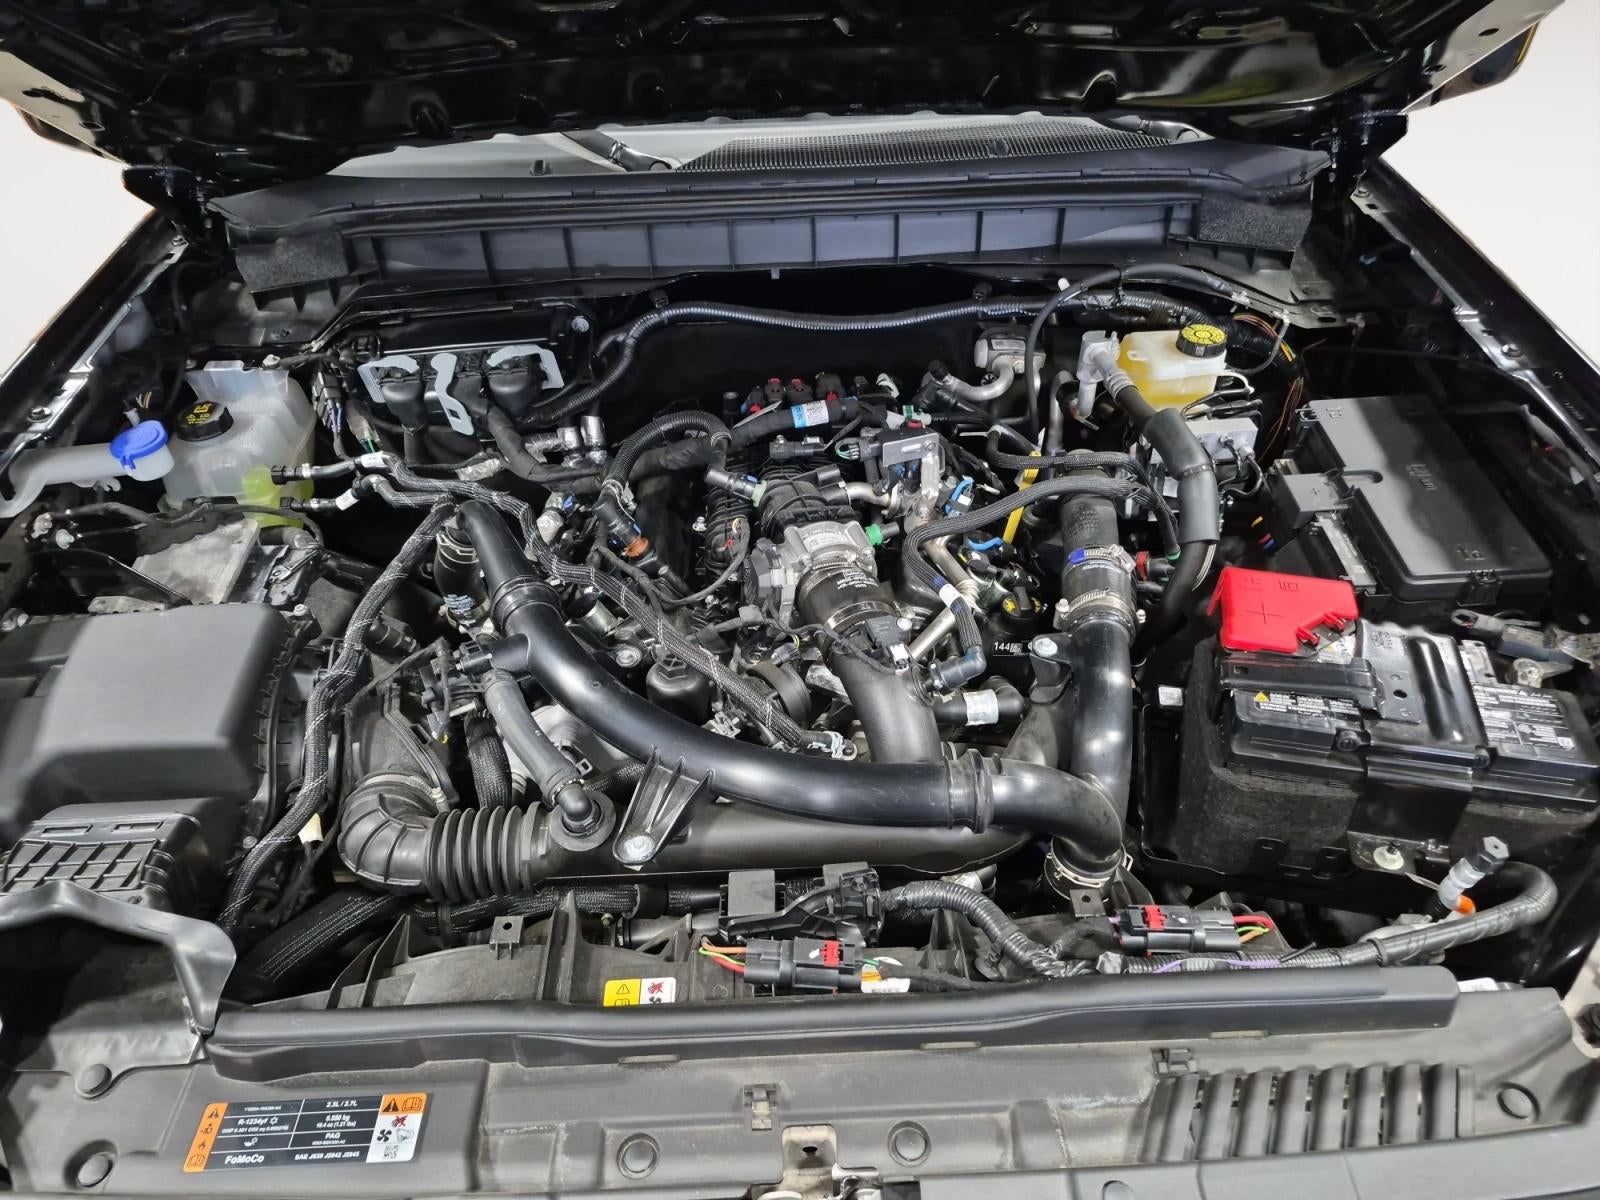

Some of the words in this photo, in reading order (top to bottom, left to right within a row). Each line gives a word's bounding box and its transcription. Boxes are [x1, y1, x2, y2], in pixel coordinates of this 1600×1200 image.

[237, 1117, 267, 1126] R-1234yf
[225, 1154, 264, 1164] FoMoCo
[294, 1153, 308, 1161] SAE
